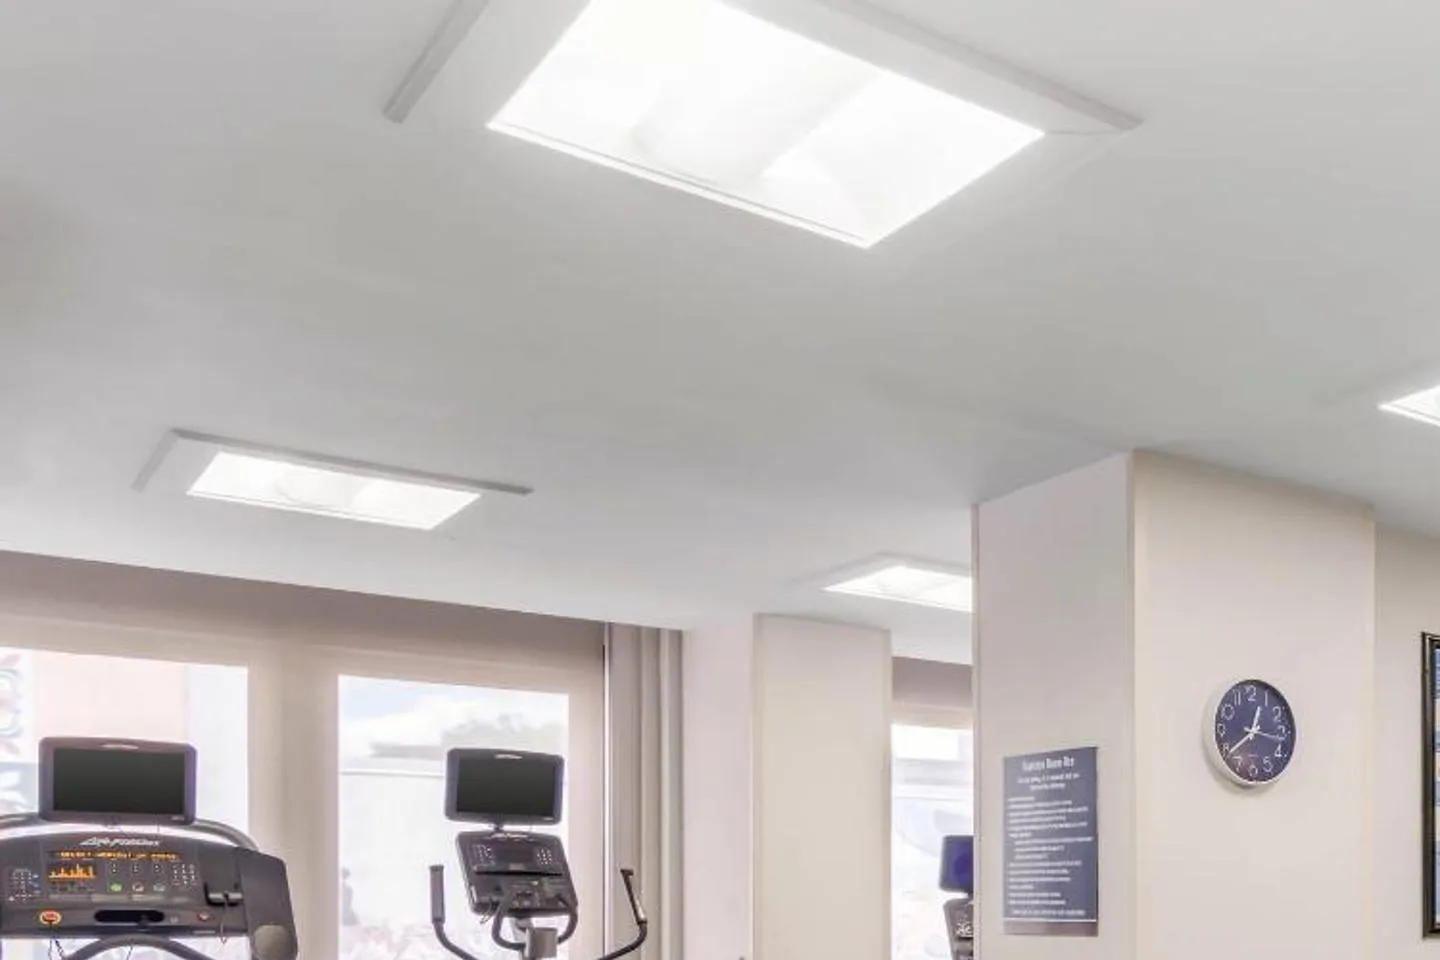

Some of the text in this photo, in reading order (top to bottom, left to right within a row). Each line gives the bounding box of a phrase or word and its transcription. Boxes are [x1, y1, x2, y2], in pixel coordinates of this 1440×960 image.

[1272, 706, 1282, 723] 2
[1274, 744, 1283, 758] 4
[1263, 756, 1274, 773] 5
